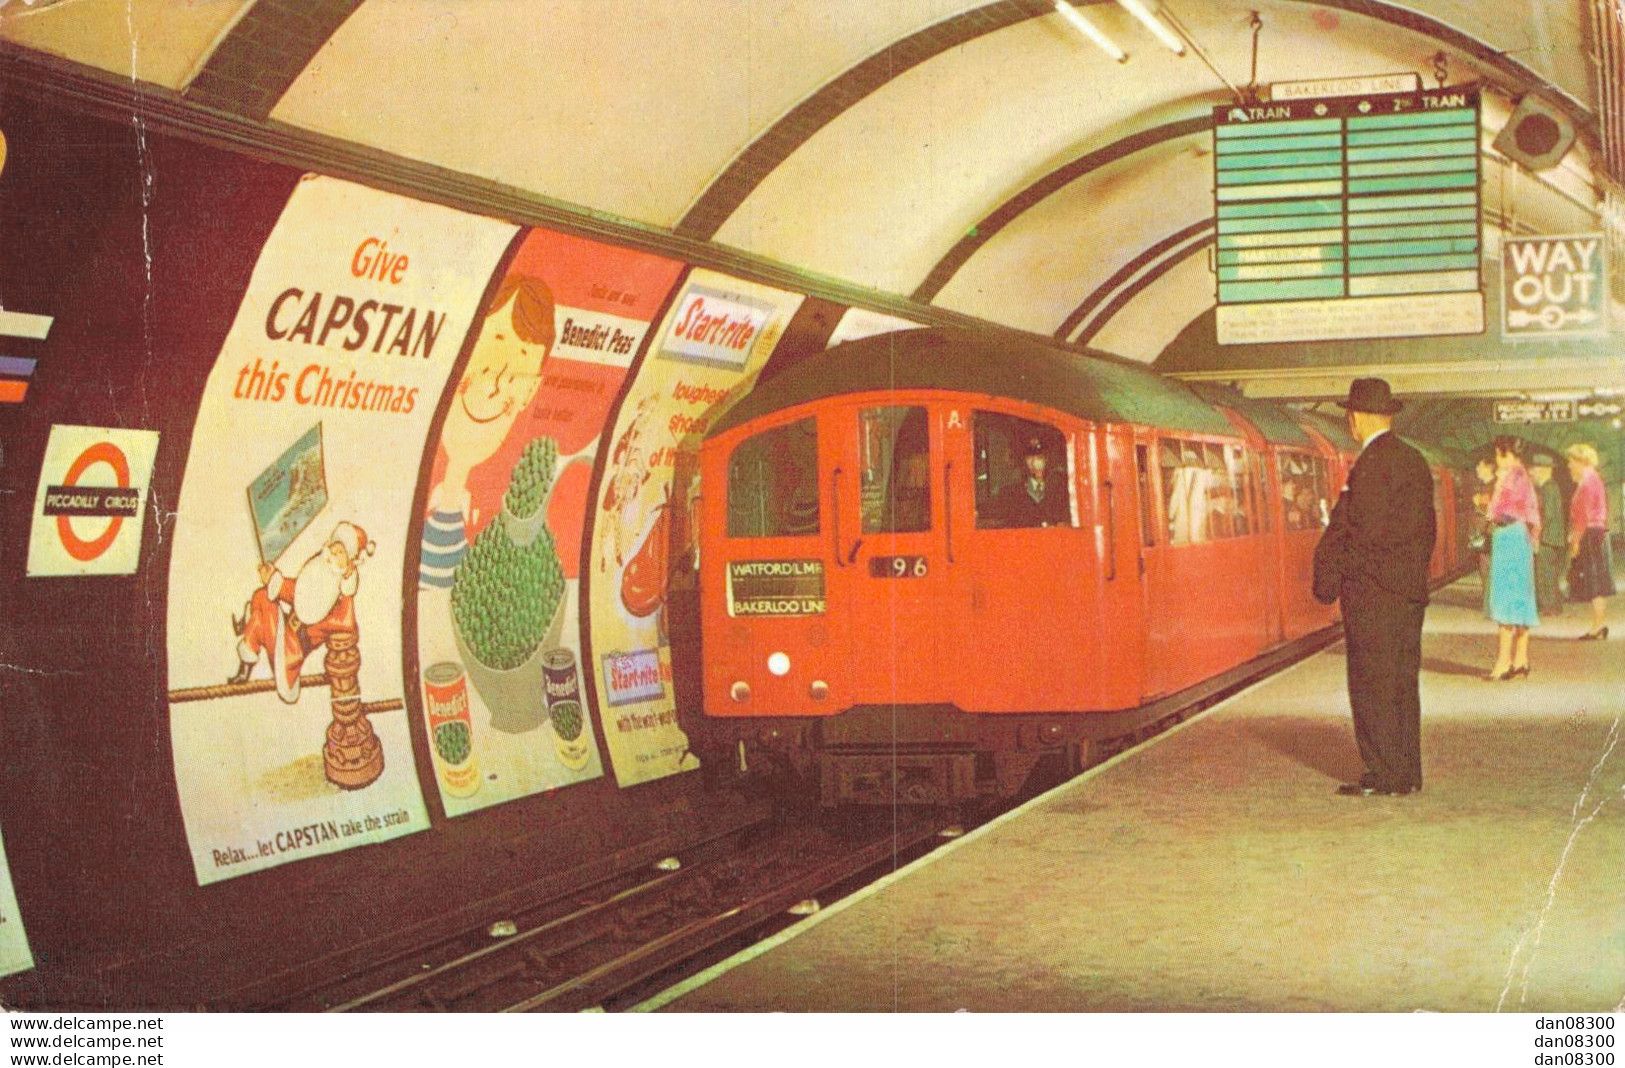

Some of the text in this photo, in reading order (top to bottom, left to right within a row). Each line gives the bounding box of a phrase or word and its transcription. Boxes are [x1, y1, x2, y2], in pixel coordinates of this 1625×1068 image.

[1247, 106, 1291, 120] TRAIN
[1422, 94, 1466, 108] TRAIN
[351, 236, 409, 285] Give
[1509, 240, 1598, 275] WAY
[1512, 272, 1596, 306] OUT
[265, 287, 447, 360] CAPSTAN
[560, 318, 636, 355] Benedict Peas
[675, 298, 755, 350] Start-rite
[234, 358, 420, 414] this Christmas
[948, 410, 963, 429] A
[46, 494, 138, 510] PICCADILLY CIRCUS
[731, 563, 792, 577] WATFORD
[734, 601, 826, 614] BAKERLOO LINE
[275, 820, 340, 852] CAPSTAN
[340, 820, 363, 837] take
[364, 814, 382, 832] the
[383, 808, 410, 826] strain
